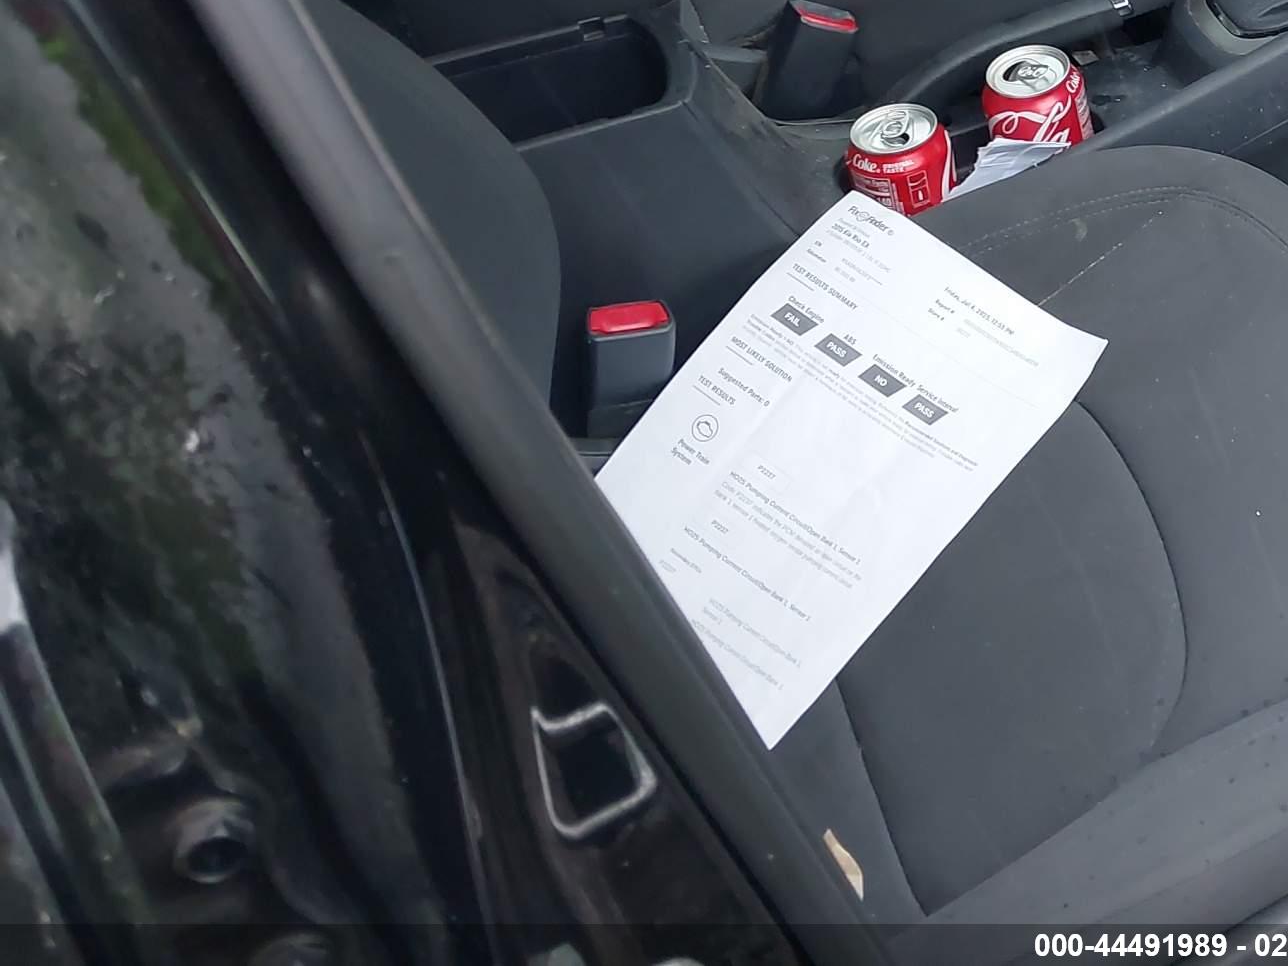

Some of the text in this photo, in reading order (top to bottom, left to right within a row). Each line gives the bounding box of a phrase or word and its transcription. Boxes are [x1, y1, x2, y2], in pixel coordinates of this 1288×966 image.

[791, 262, 806, 274] TEST
[804, 271, 829, 290] RESULTS
[827, 287, 857, 309] SUMMARY
[783, 311, 800, 326] FAIL
[787, 294, 824, 323] Check Engine
[826, 341, 846, 357] PASS
[842, 333, 857, 345] ABS
[730, 335, 792, 382] MOST LIKELY SOLUTION
[872, 353, 916, 387] Emission Ready
[697, 374, 736, 405] TEST RESULTS
[717, 367, 749, 391] Suggested
[746, 387, 764, 403] Parts:
[873, 374, 887, 386] NO
[916, 383, 938, 401] Service
[913, 401, 934, 418] PASS
[670, 446, 691, 465] System
[677, 437, 710, 464] Power Train
